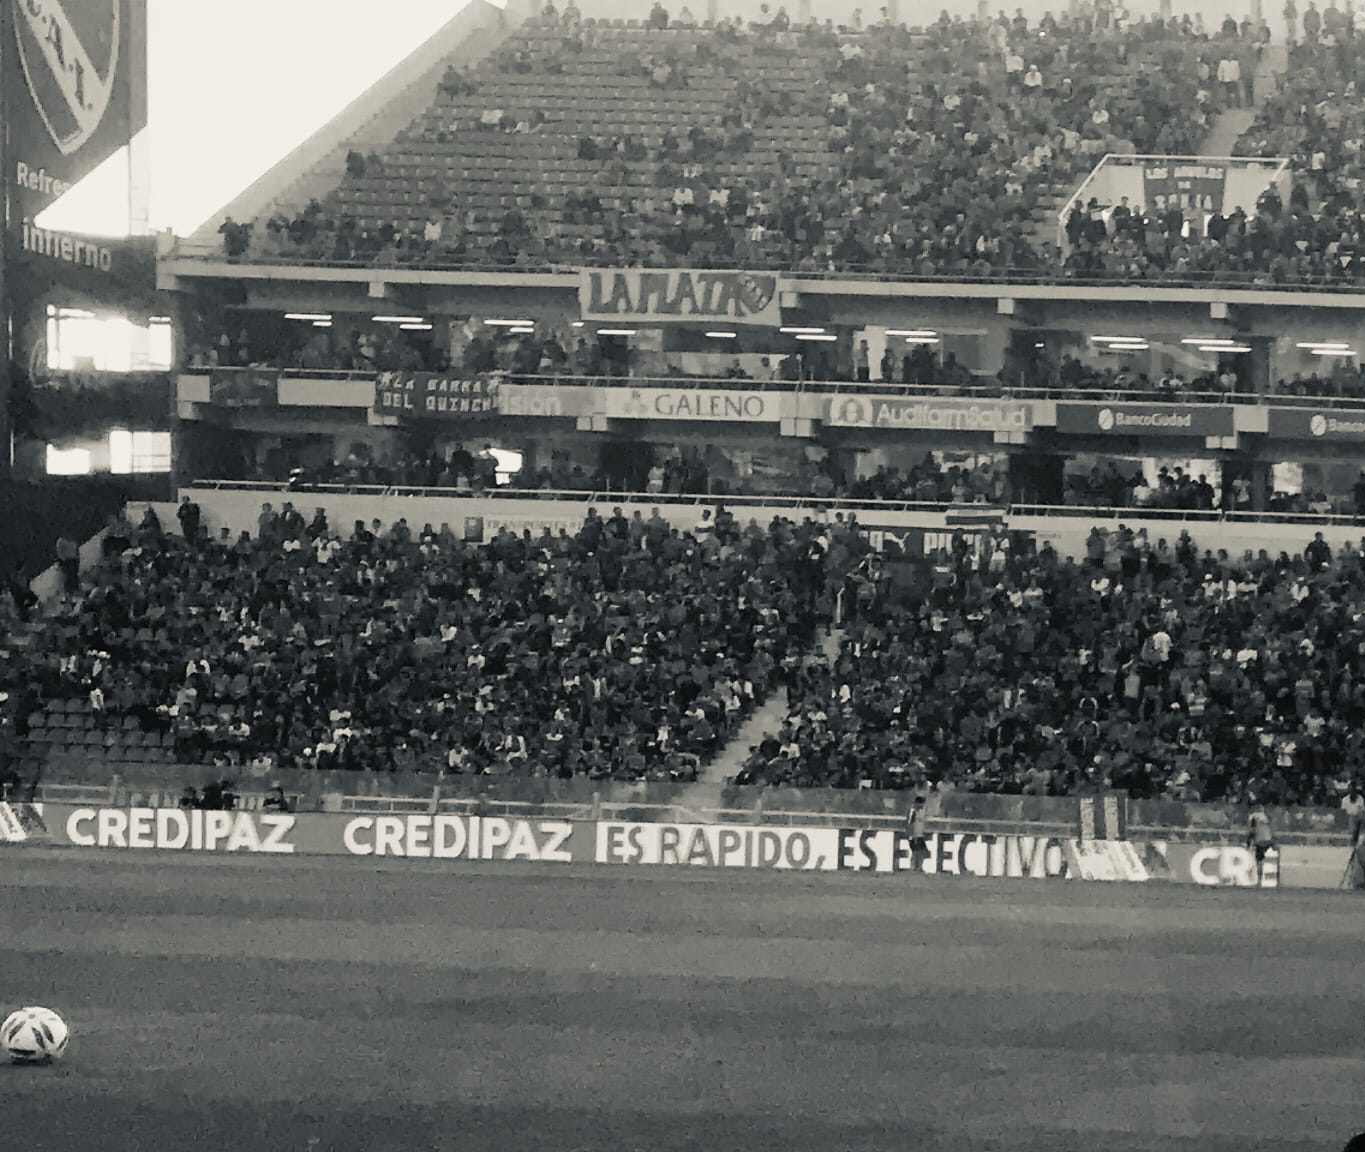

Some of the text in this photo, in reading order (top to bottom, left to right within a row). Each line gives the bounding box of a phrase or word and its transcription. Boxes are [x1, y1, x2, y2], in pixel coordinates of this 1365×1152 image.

[654, 394, 765, 417] GALENO
[66, 808, 295, 853] CREDIPAZ
[343, 815, 573, 862] CREDIPAZ
[606, 825, 644, 864] ES
[838, 829, 878, 871] ES
